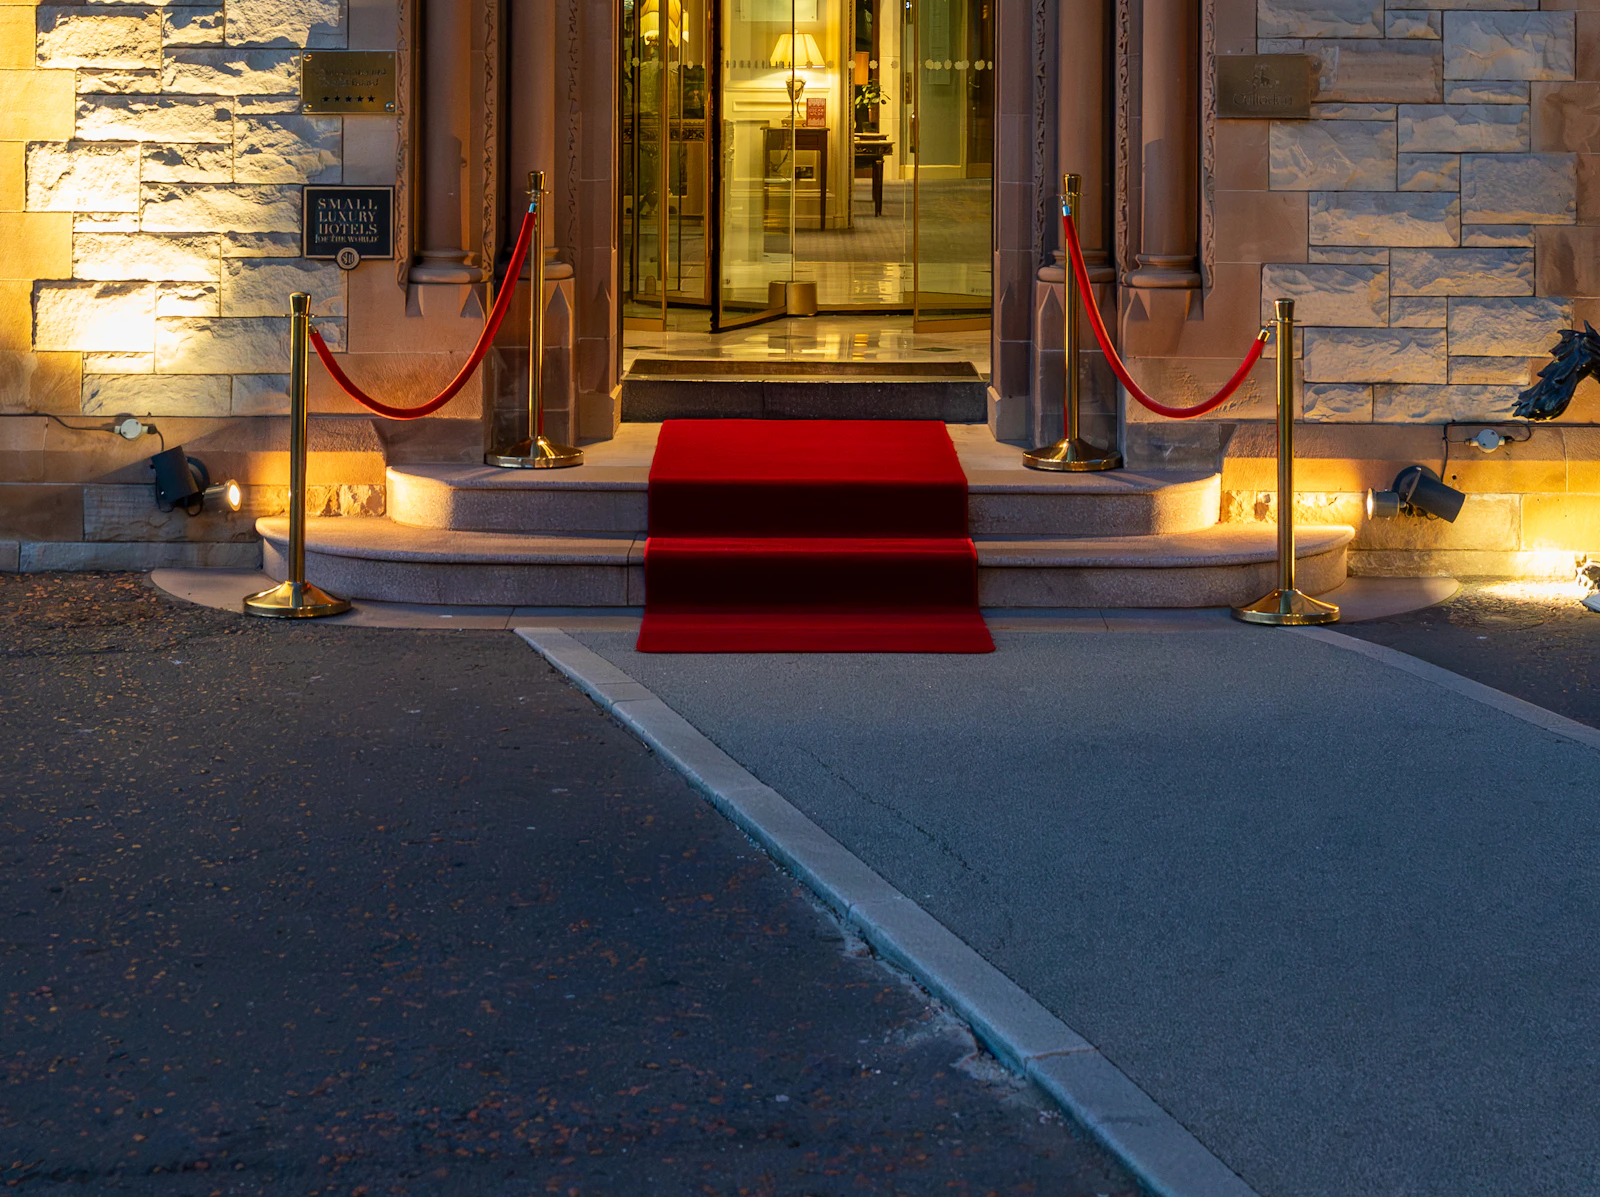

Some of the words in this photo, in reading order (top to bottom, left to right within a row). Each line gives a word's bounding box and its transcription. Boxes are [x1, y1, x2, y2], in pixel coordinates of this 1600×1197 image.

[318, 198, 378, 210] SMALL
[319, 211, 376, 222] LUXURY
[319, 223, 377, 235] HOTELS
[347, 235, 377, 243] WORLD
